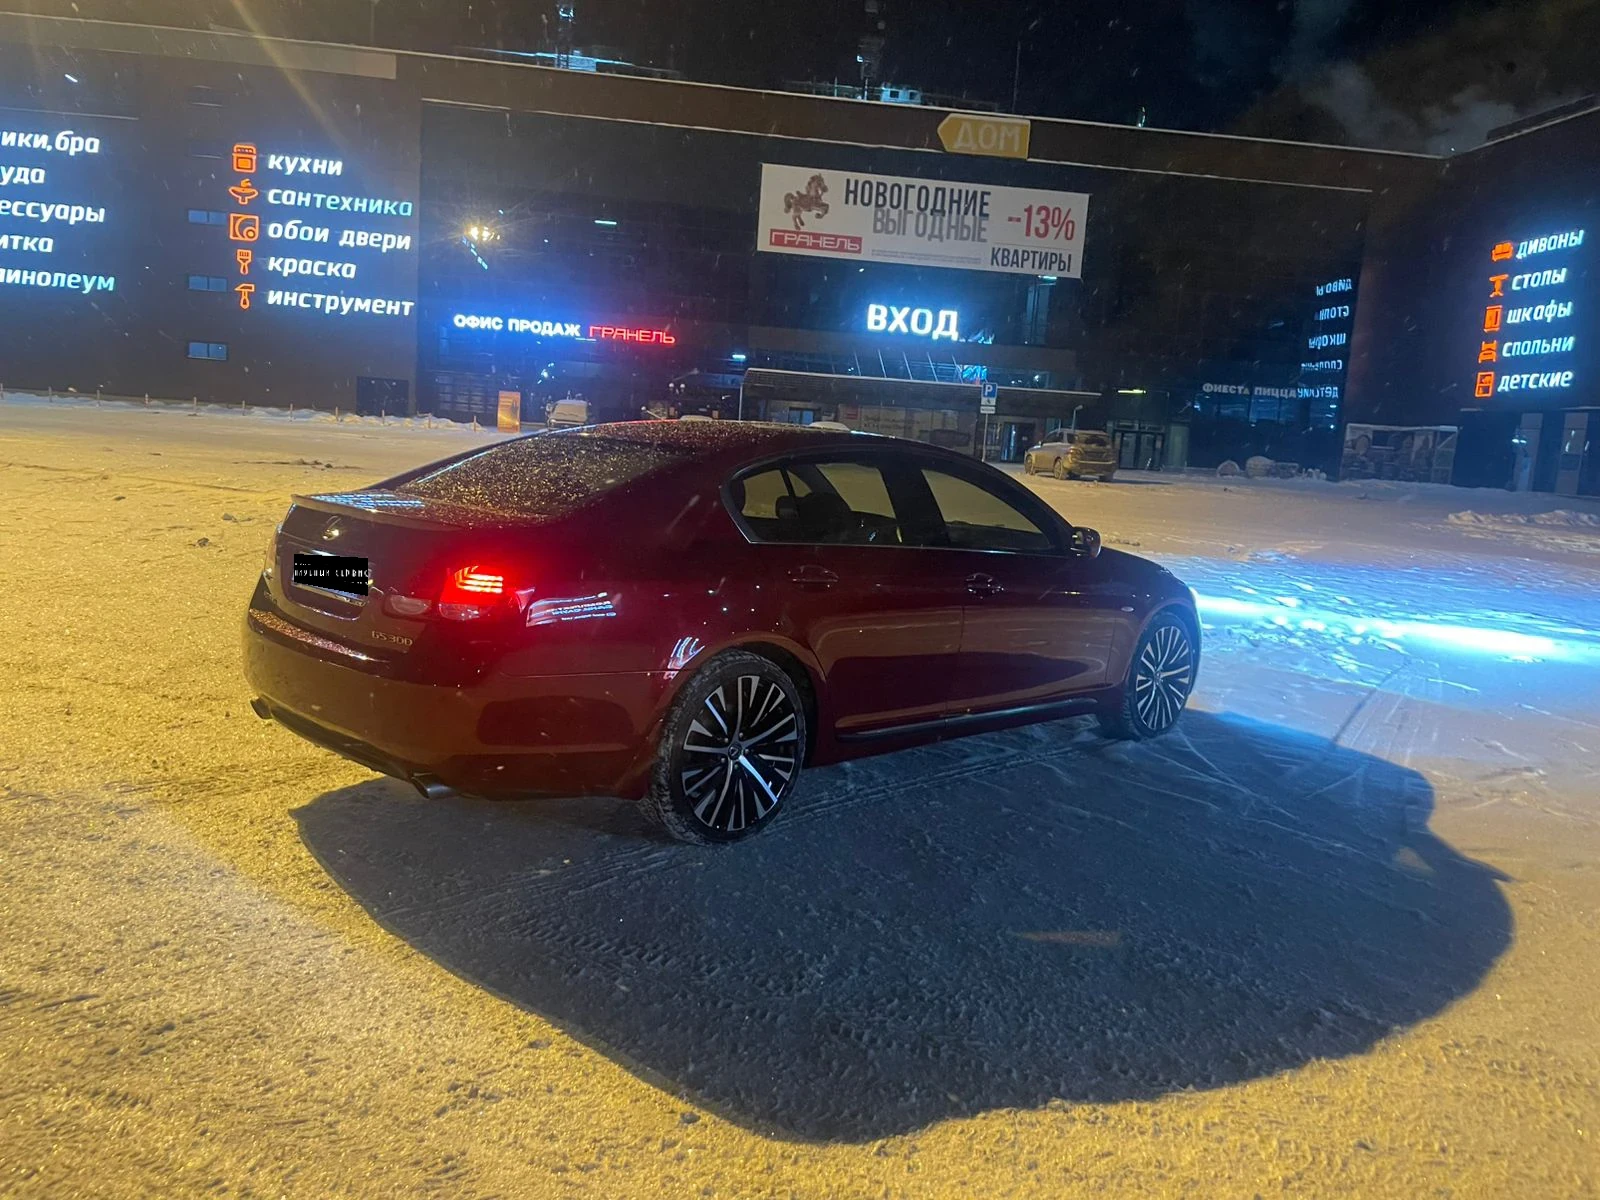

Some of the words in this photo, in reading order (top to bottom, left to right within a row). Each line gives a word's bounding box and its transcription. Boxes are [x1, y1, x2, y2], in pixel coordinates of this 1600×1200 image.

[0, 130, 100, 156] ики,бра
[954, 121, 1021, 152] ДОМ
[268, 153, 343, 177] кухни
[267, 187, 413, 217] сантехника
[844, 178, 991, 218] НОВОГОДНИЕ
[872, 207, 989, 243] ВЫГОДНЫЕ
[1007, 204, 1075, 241] -13%
[267, 219, 330, 243] обои
[338, 229, 412, 253] двери
[770, 230, 861, 252] ГРАНЕЛЬ
[1515, 229, 1585, 260] диваны
[267, 256, 357, 280] краска
[990, 246, 1072, 273] КВАРТИРЫ
[1511, 267, 1567, 291] столы
[267, 289, 415, 316] инструмент
[1506, 299, 1573, 323] шкафы
[453, 314, 503, 331] ОФИС
[507, 318, 581, 337] ПРОДАЖ
[588, 325, 676, 345] ГРАНЕЛЬ
[867, 303, 960, 342] ВХОД
[1501, 335, 1576, 357] спальни
[1202, 382, 1250, 395] ФИЕСТА
[1254, 386, 1297, 399] ПИЦЦА
[1497, 370, 1574, 392] детские
